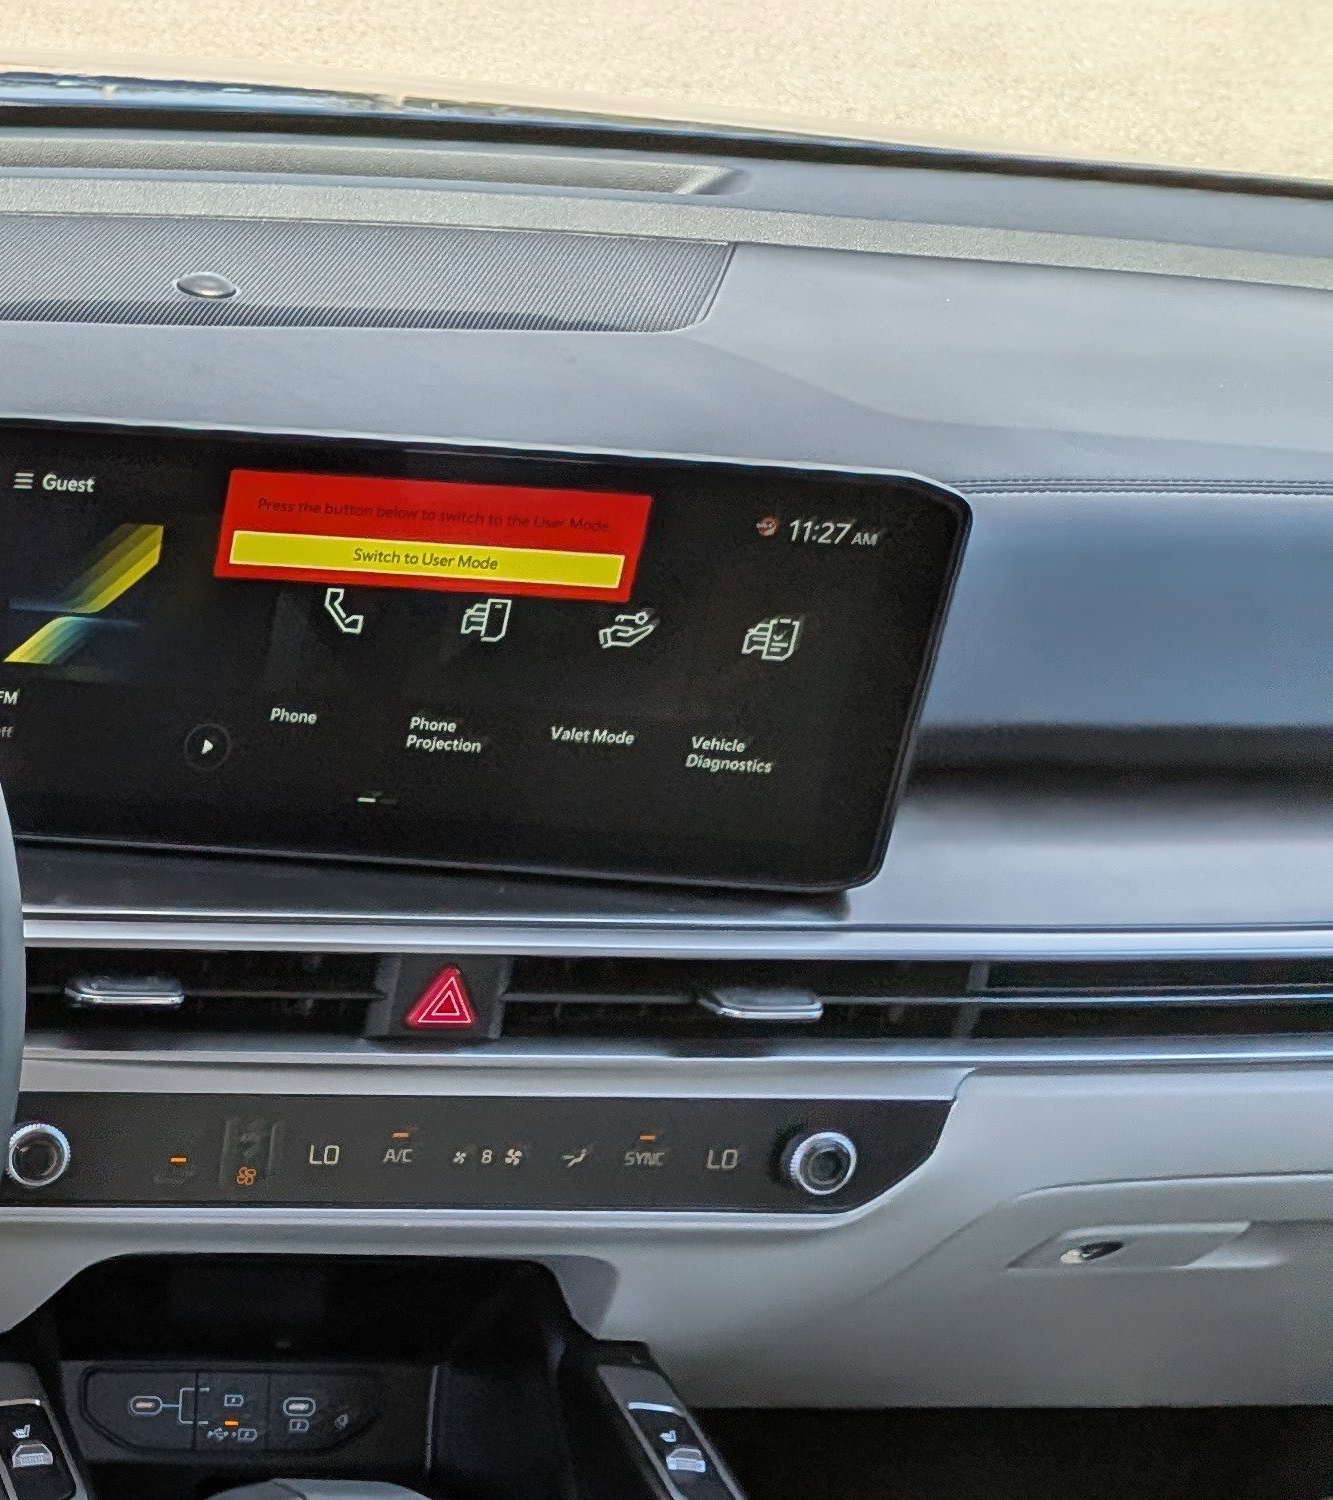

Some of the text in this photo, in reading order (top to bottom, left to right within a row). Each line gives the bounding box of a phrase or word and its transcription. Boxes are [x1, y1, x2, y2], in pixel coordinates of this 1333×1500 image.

[42, 473, 95, 493] Guest
[258, 496, 294, 512] Press
[298, 501, 321, 514] the
[324, 502, 372, 517] button
[377, 505, 419, 520] below
[422, 508, 436, 521] to
[439, 510, 484, 525] switch
[488, 513, 503, 527] to
[507, 513, 530, 528] the
[534, 516, 564, 529] User
[790, 518, 879, 546] 11:27 AM
[353, 547, 499, 570] Switch to User Mode
[269, 707, 318, 725] Phone
[410, 715, 457, 733] Phone
[406, 734, 482, 754] Projection
[550, 725, 635, 746] Valet Mode
[692, 735, 746, 754] Vehicle
[685, 753, 773, 774] Diagnostics
[309, 1143, 340, 1165] LO
[383, 1147, 414, 1164] A/C
[624, 1151, 664, 1167] SYNC
[706, 1148, 738, 1170] LO
